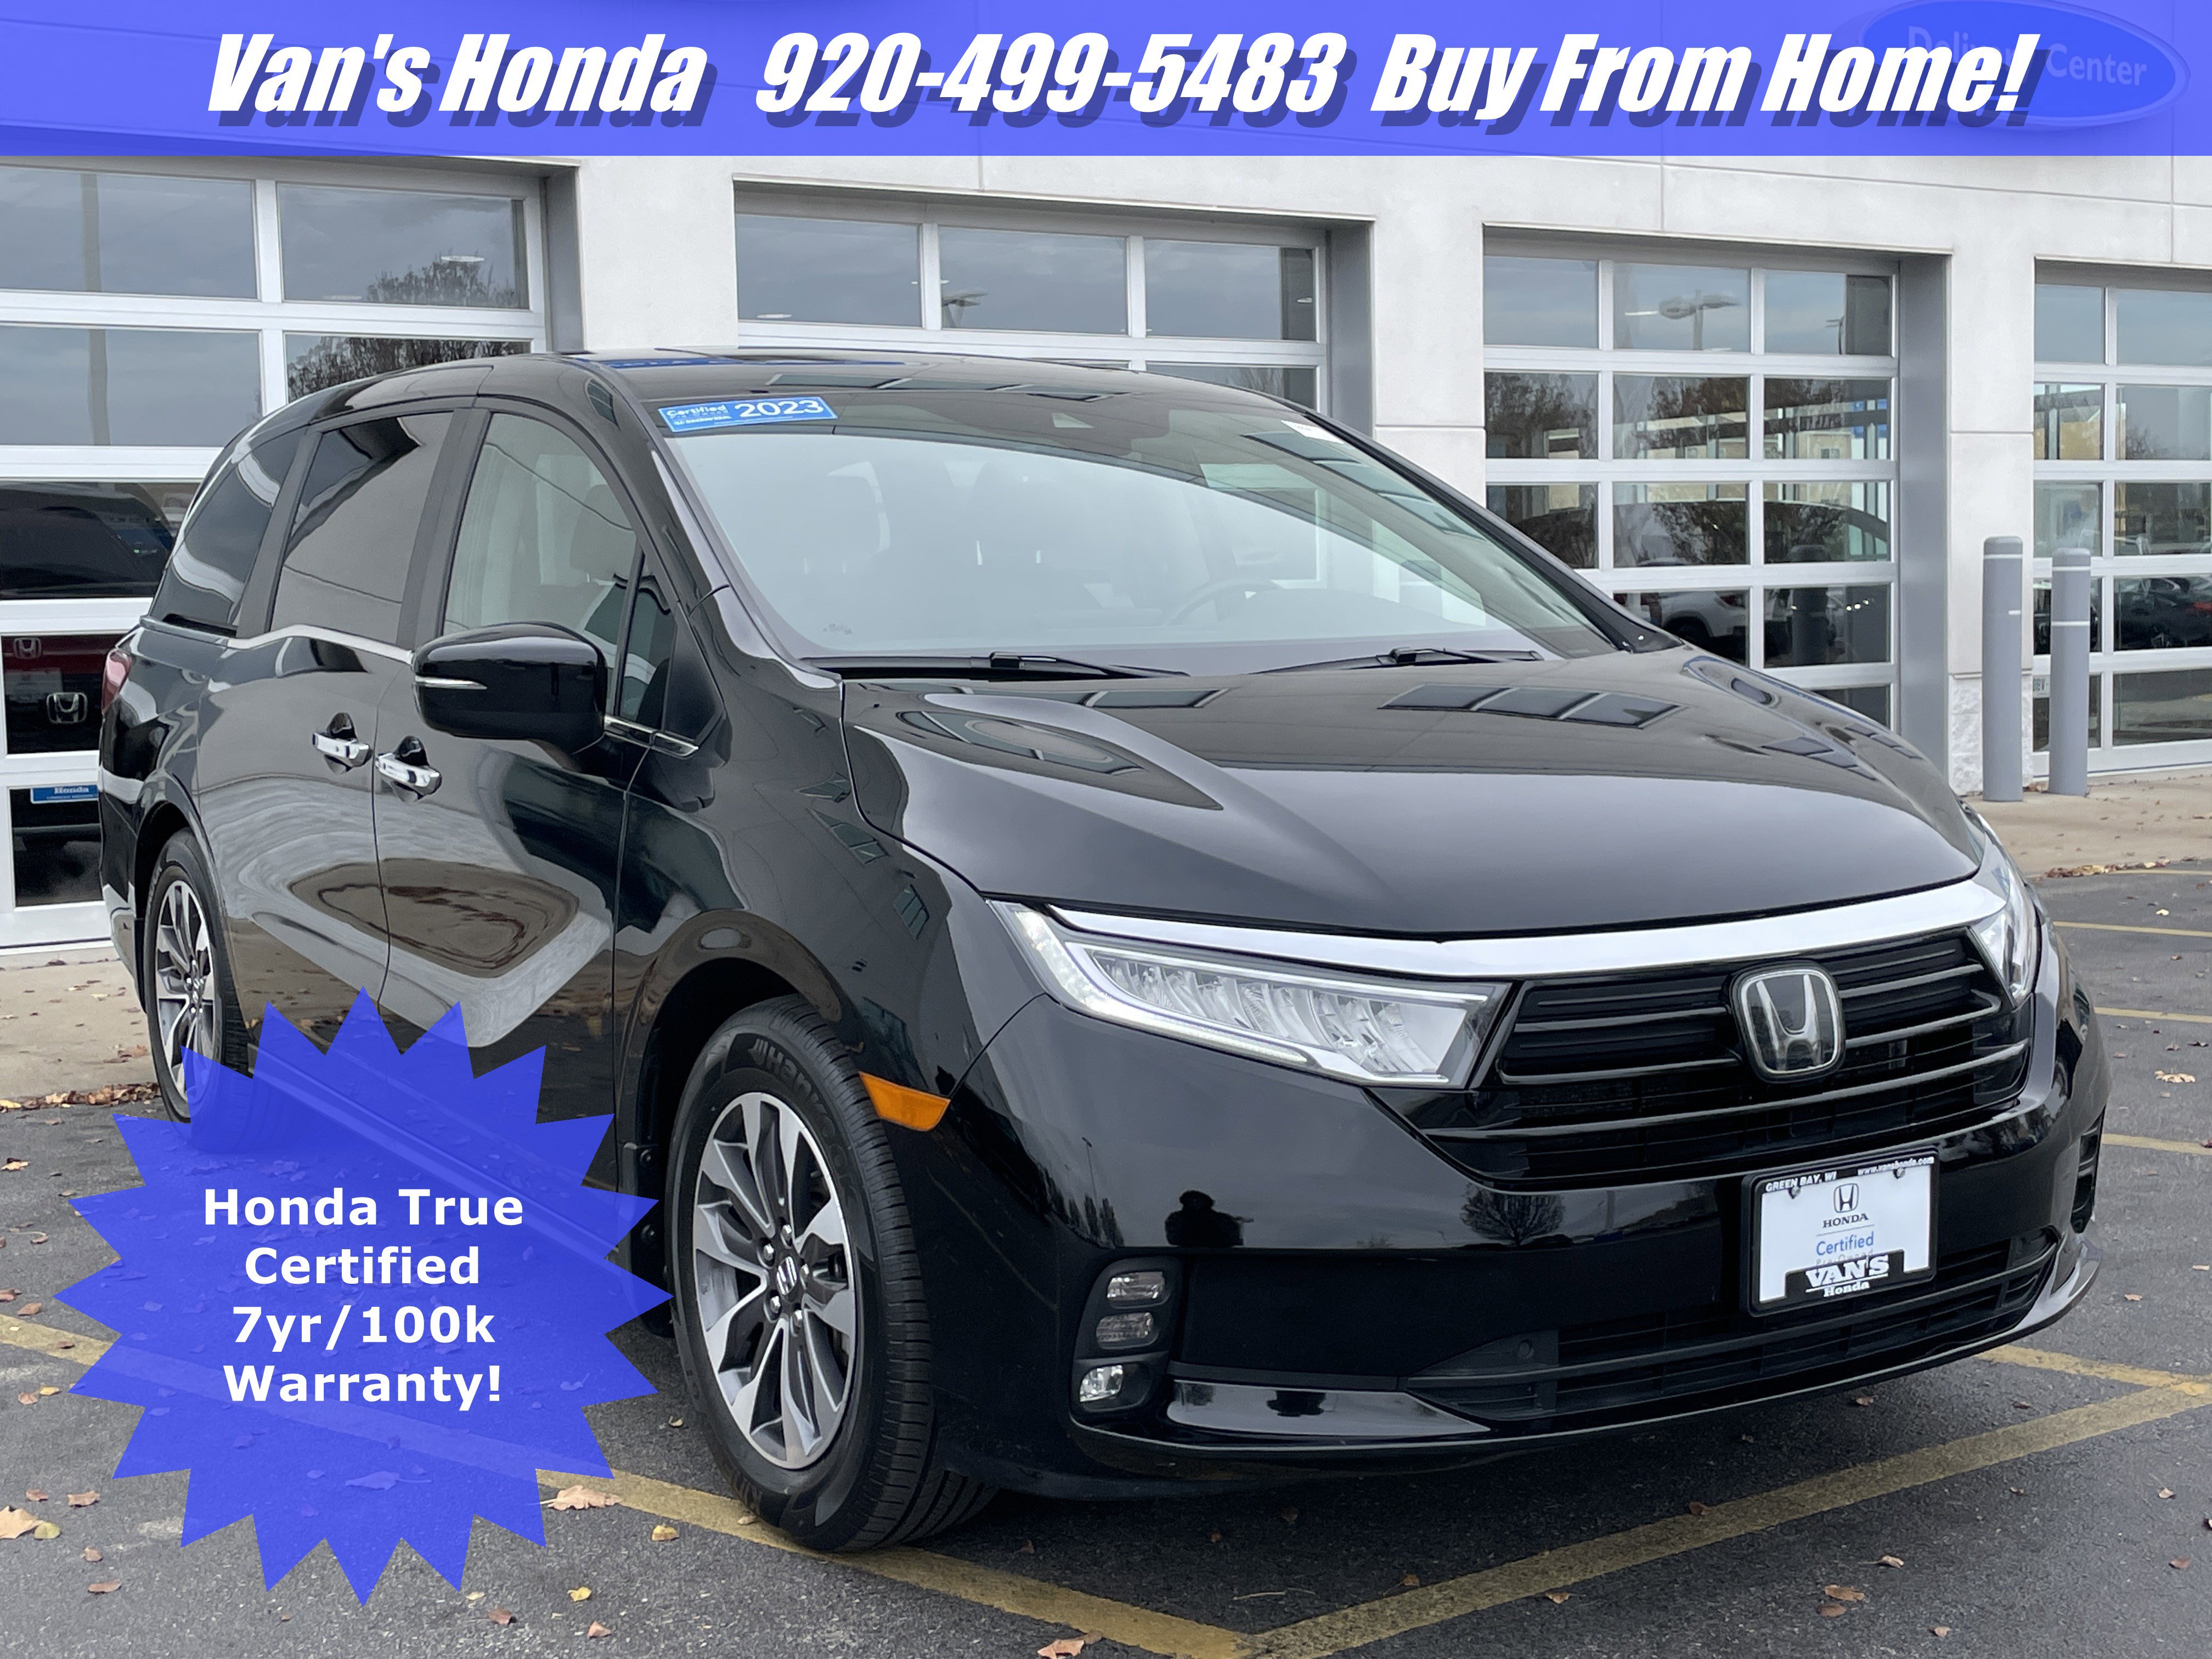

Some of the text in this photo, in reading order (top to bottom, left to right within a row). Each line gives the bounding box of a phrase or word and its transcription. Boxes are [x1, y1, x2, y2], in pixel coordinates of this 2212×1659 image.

[2045, 42, 2148, 87] Center
[667, 404, 727, 416] Certified
[735, 399, 824, 418] 2023
[1765, 1177, 1799, 1193] GREEN
[1824, 1171, 1837, 1182] WI
[1822, 1212, 1869, 1228] HONDA
[1816, 1231, 1875, 1256] Certified
[1823, 1281, 1870, 1297] Honda
